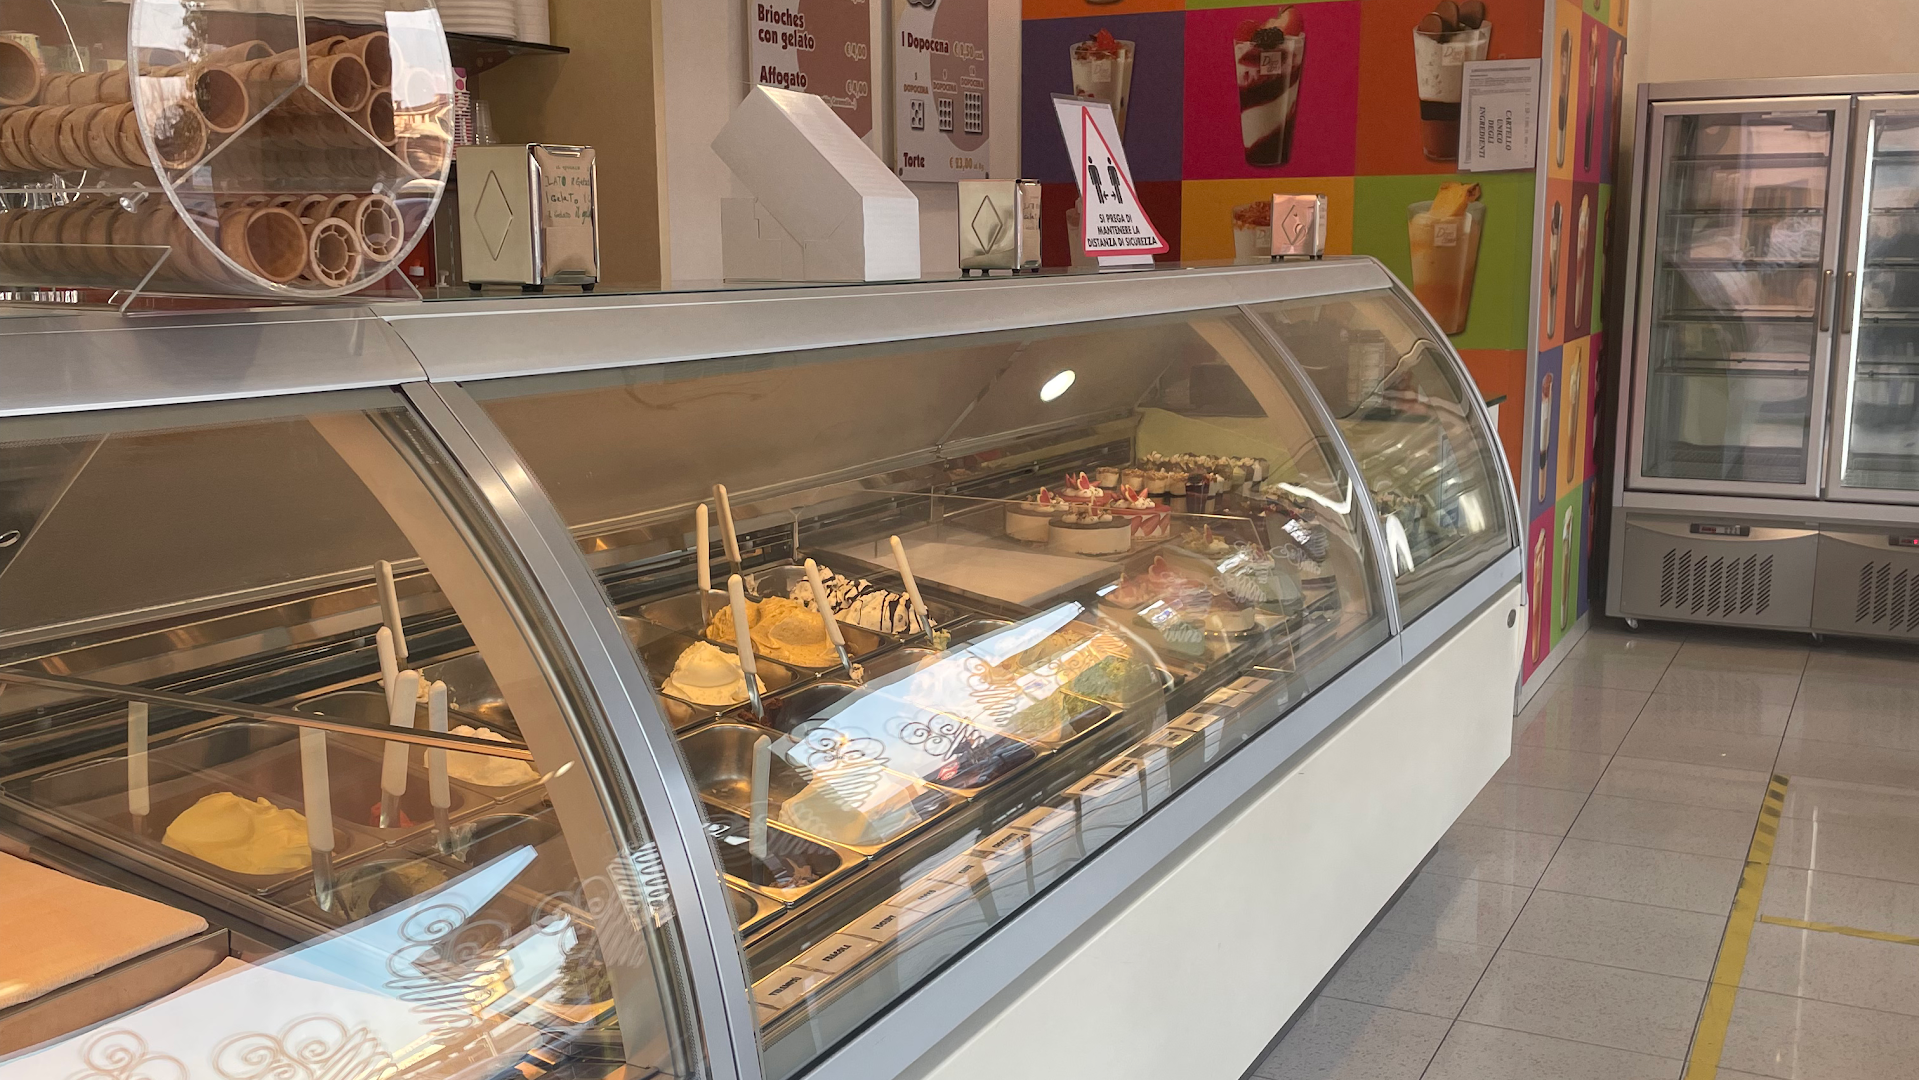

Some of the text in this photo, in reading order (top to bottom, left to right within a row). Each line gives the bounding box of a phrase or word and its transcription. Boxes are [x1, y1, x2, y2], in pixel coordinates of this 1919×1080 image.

[758, 4, 804, 28] Brioches
[758, 28, 815, 50] con gelato
[907, 32, 949, 53] Dopocena
[760, 65, 807, 89] Affogato
[1478, 106, 1486, 158] INGREDIENTI
[1487, 119, 1495, 144] DEGLI
[1496, 118, 1504, 144] UNICO
[1505, 110, 1513, 151] CARTELLO
[903, 152, 925, 168] Torte
[1099, 214, 1133, 223] SI PREGA DI
[1087, 236, 1158, 248] DISTANZA DI SICUREZZA
[1097, 226, 1141, 235] MANTENERE LA
